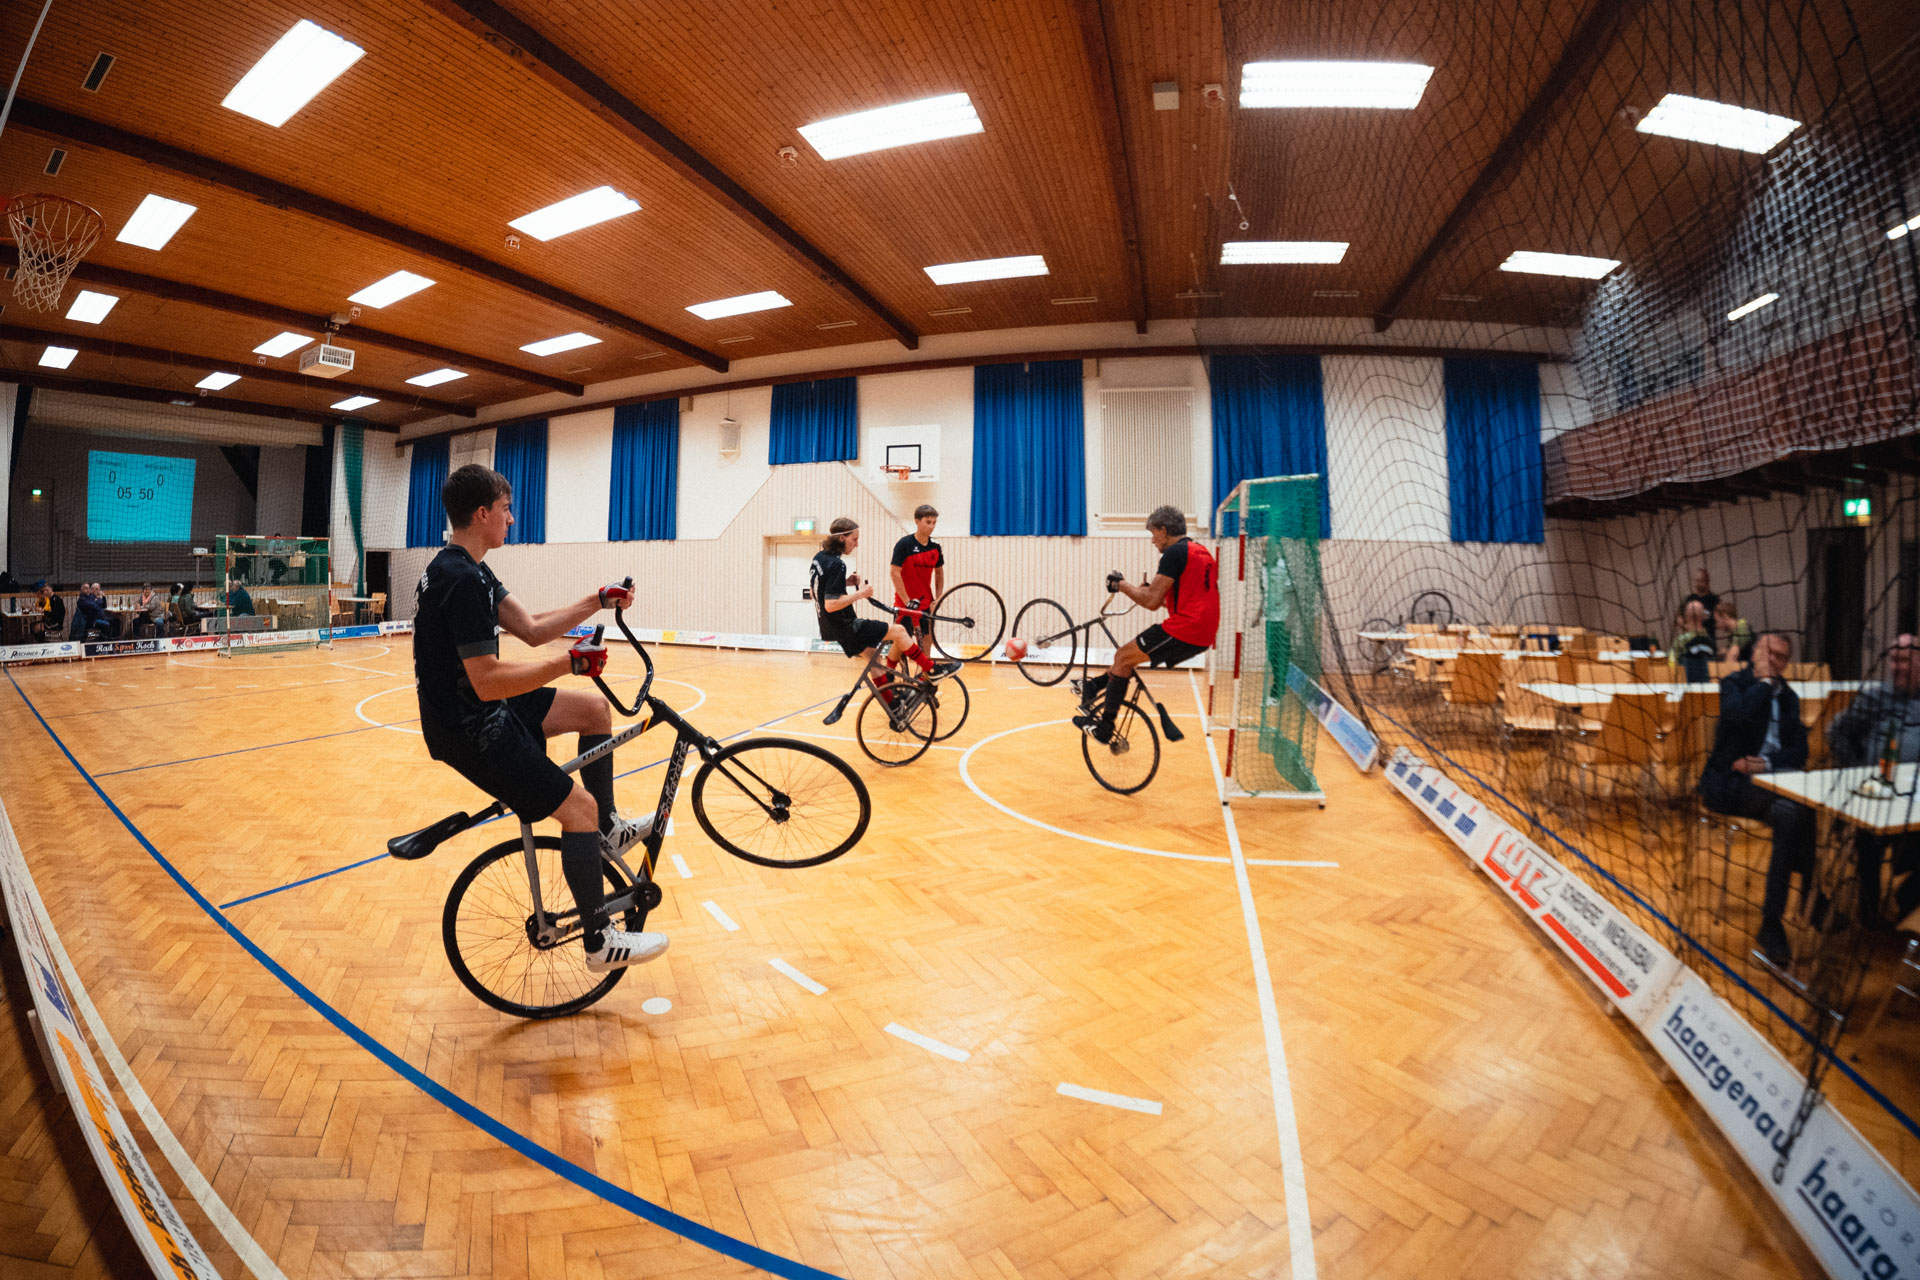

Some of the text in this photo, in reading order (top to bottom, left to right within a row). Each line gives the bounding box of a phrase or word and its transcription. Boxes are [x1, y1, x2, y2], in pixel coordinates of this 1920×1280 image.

[108, 470, 165, 487] 0 0
[117, 486, 154, 501] 05 50
[95, 643, 113, 653] Rad
[135, 640, 155, 650] Koch
[1483, 829, 1564, 907] LUTZ
[1666, 1004, 1791, 1157] haargenau
